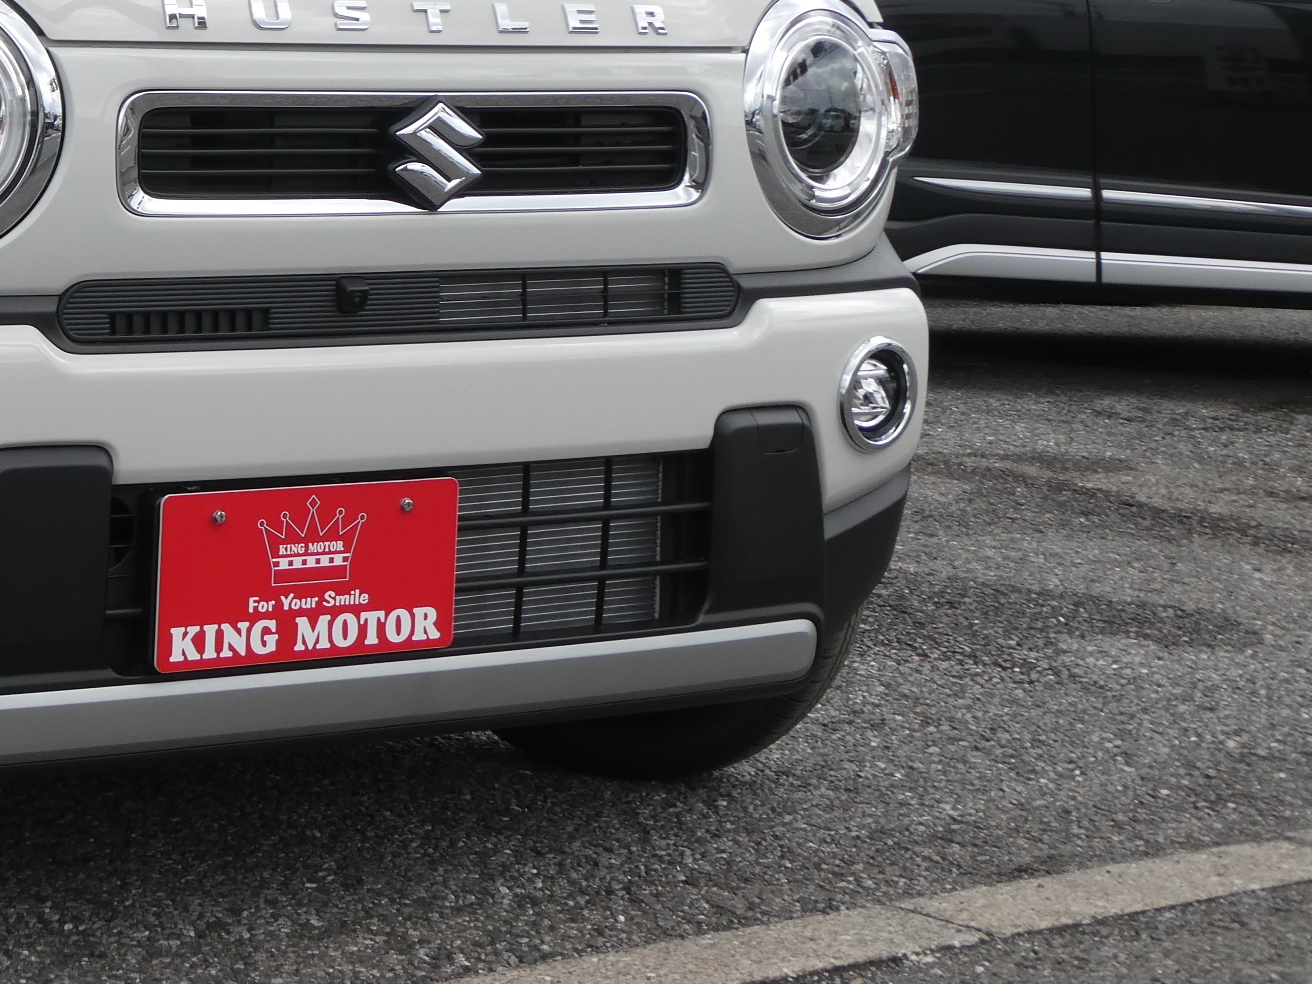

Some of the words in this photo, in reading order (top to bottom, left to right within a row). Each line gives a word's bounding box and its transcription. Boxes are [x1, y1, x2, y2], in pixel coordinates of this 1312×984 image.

[279, 543, 305, 555] KING
[308, 540, 344, 553] MOTOR
[248, 597, 275, 613] For
[280, 593, 318, 611] Your
[323, 589, 369, 607] Smile
[169, 619, 278, 662] KING
[294, 606, 440, 652] MOTOR
